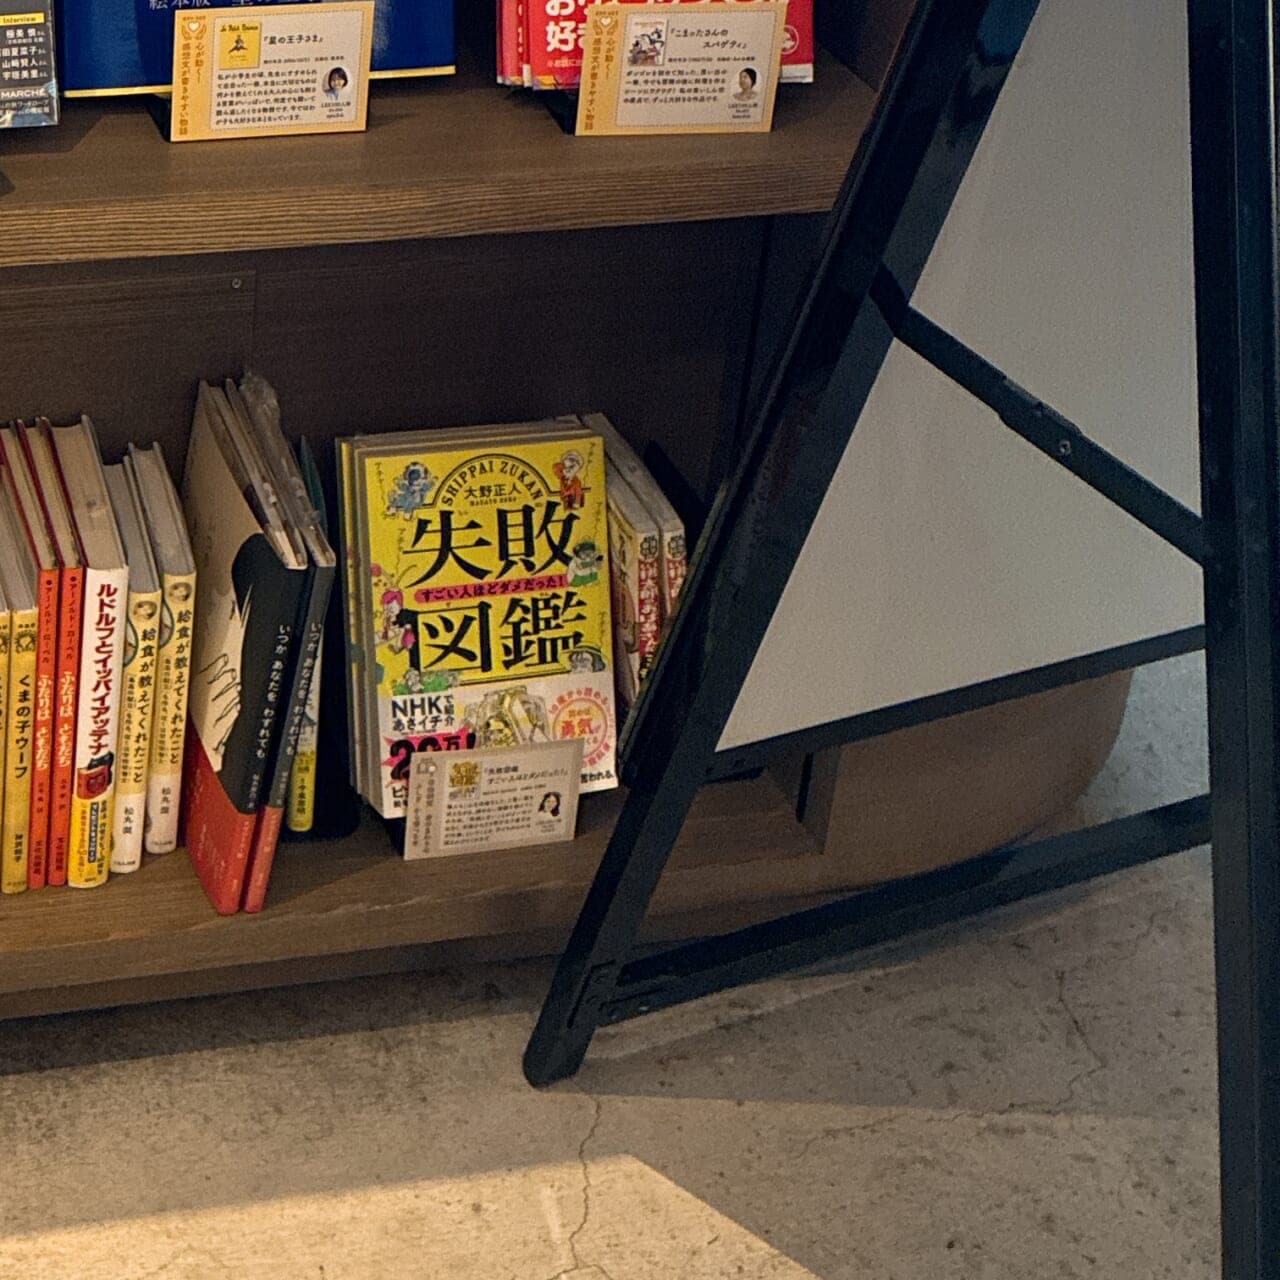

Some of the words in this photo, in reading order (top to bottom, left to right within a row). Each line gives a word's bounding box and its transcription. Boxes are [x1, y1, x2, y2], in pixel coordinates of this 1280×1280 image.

[441, 460, 495, 507] SHIPPAI
[500, 461, 544, 501] ZUKAN
[464, 483, 522, 500] 大野正人
[404, 500, 581, 588] 失敗
[276, 624, 290, 654] いつか
[408, 591, 587, 673] 図鑑
[87, 583, 118, 756] ルドルフとイッパイアッテナ
[170, 610, 192, 764] 給食が教えてくれたこと
[267, 661, 283, 702] あなたを
[15, 675, 32, 778] くまの子ウーフ
[133, 628, 155, 783] 給食が教えてくれたこと
[391, 697, 443, 718] NHK
[392, 717, 442, 732] あさイチ
[256, 707, 275, 759] わすれても
